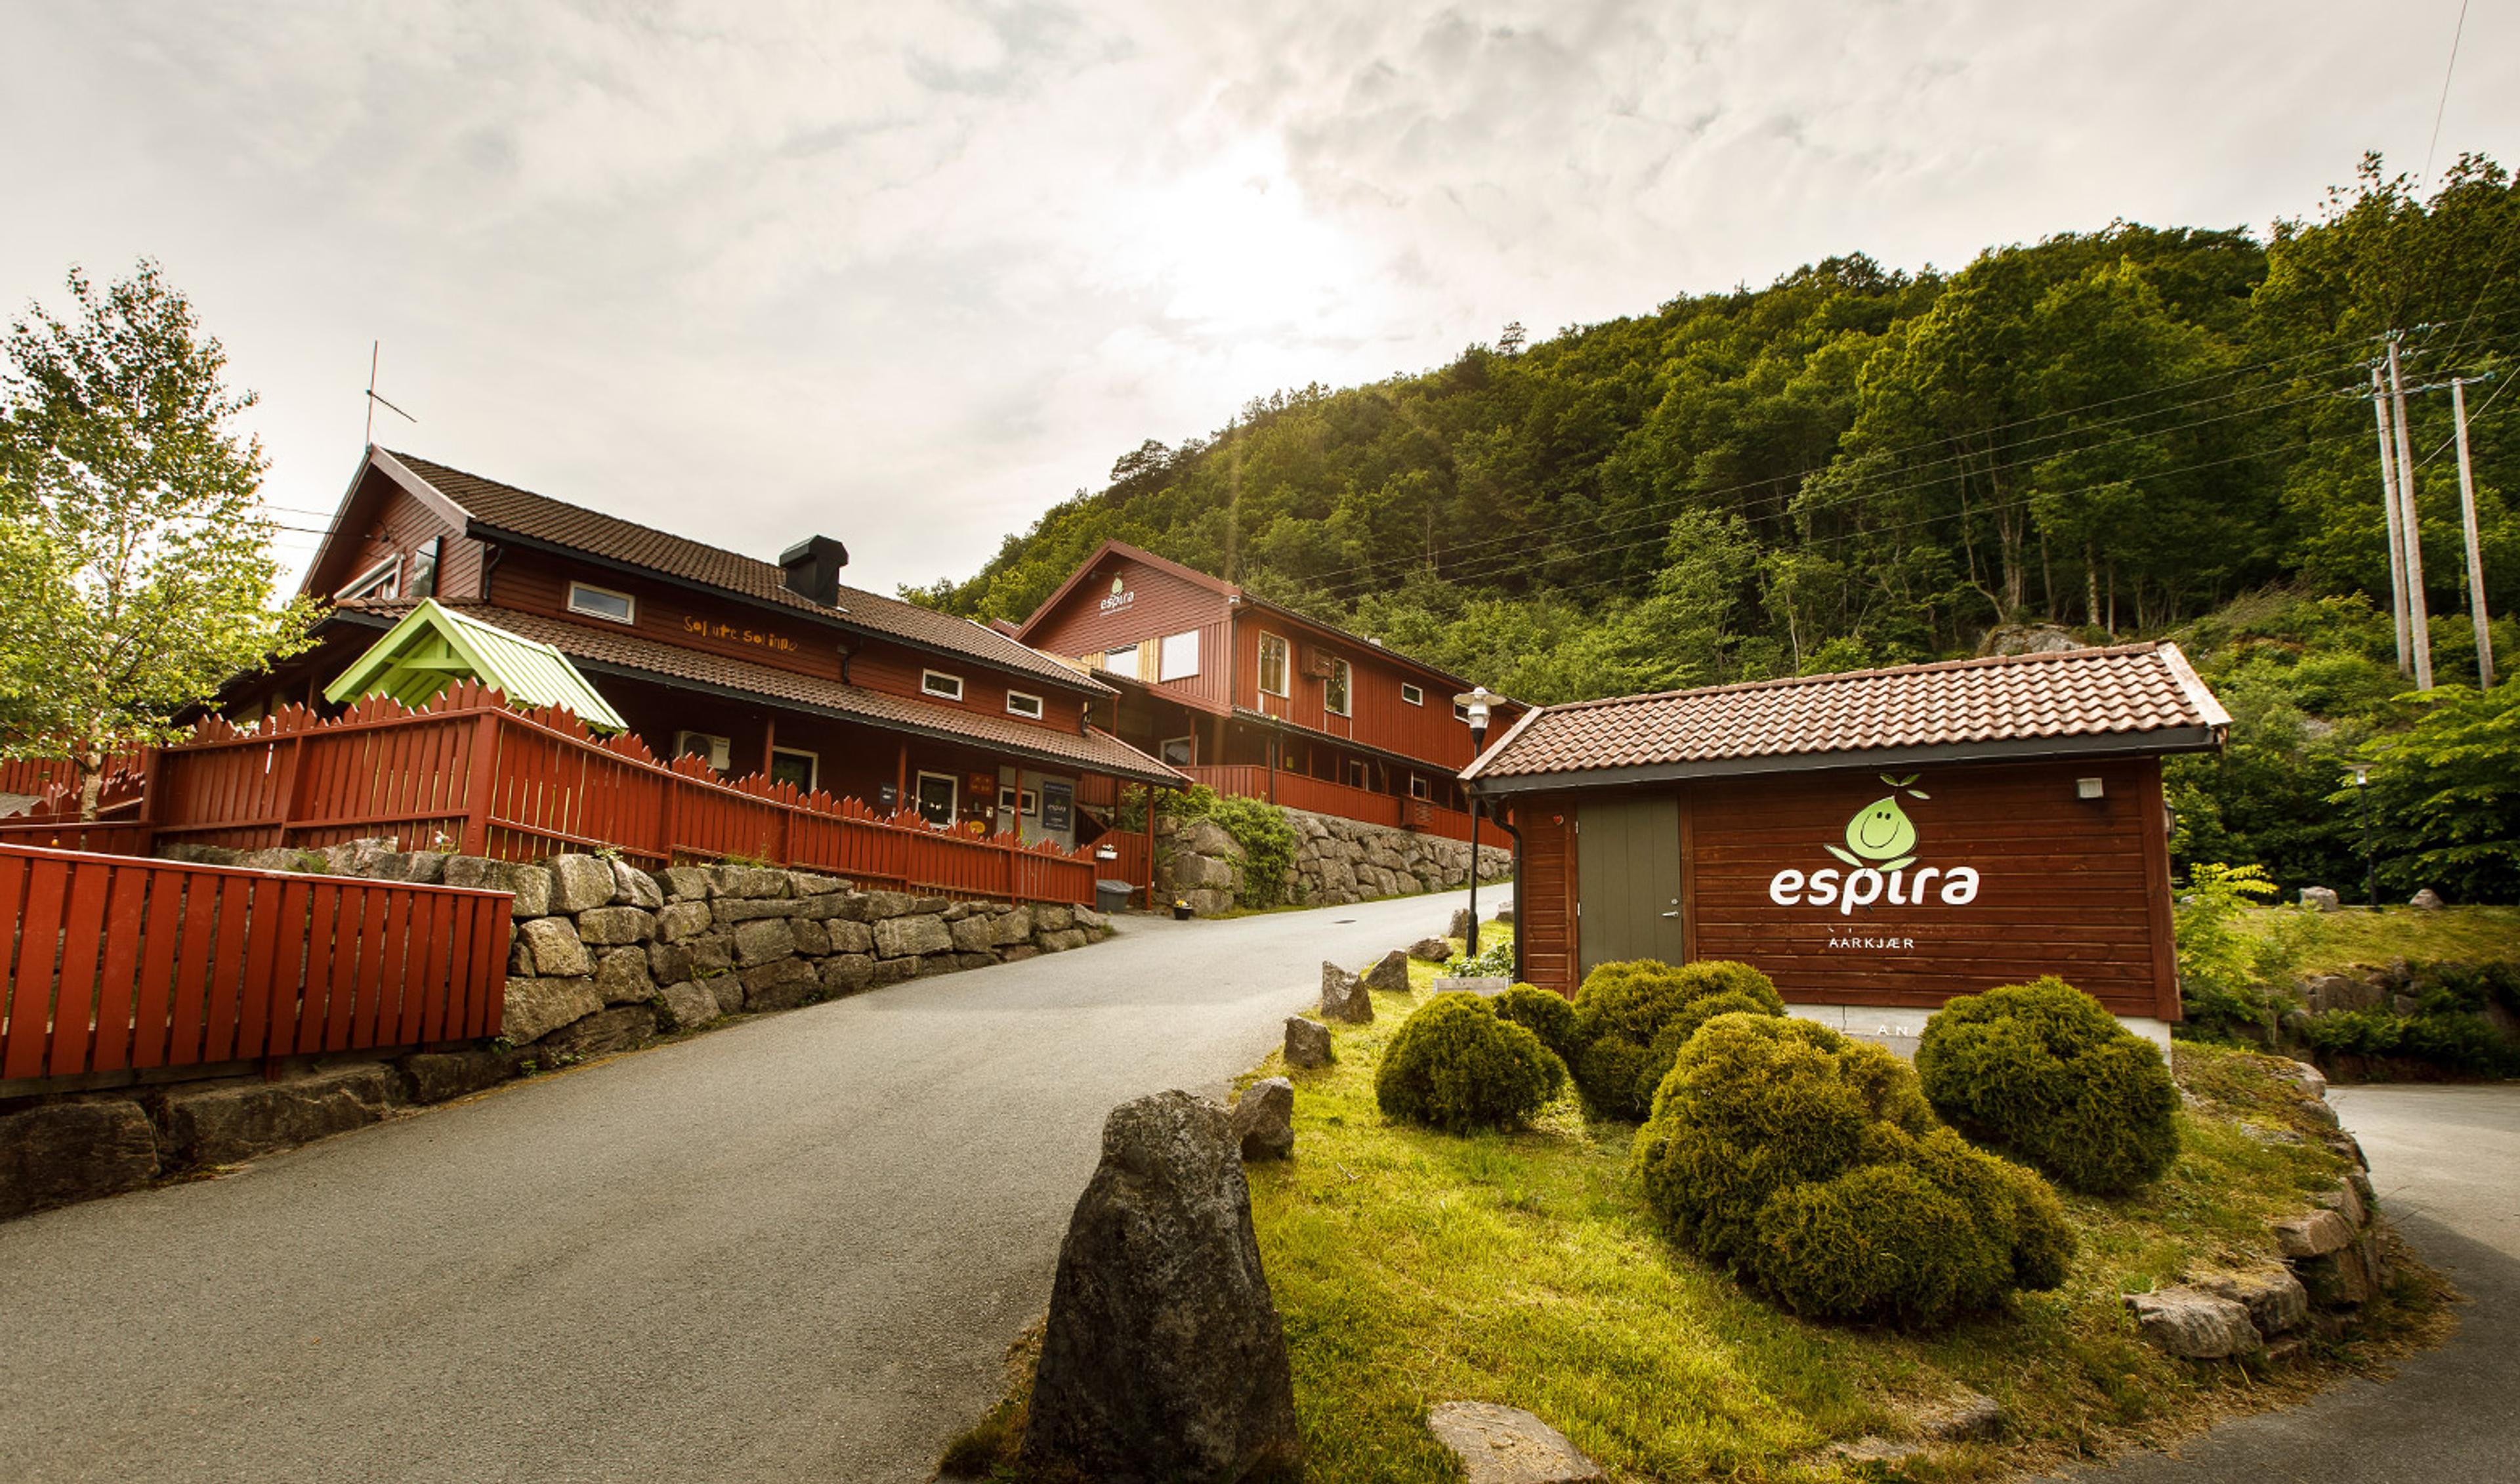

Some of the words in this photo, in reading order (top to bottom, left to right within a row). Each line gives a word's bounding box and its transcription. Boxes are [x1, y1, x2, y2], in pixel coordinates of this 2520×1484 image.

[1101, 591, 1134, 609] espira
[684, 616, 707, 637] Sol
[1770, 866, 1979, 916] espira
[1829, 937, 1914, 948] AARKJÆR
